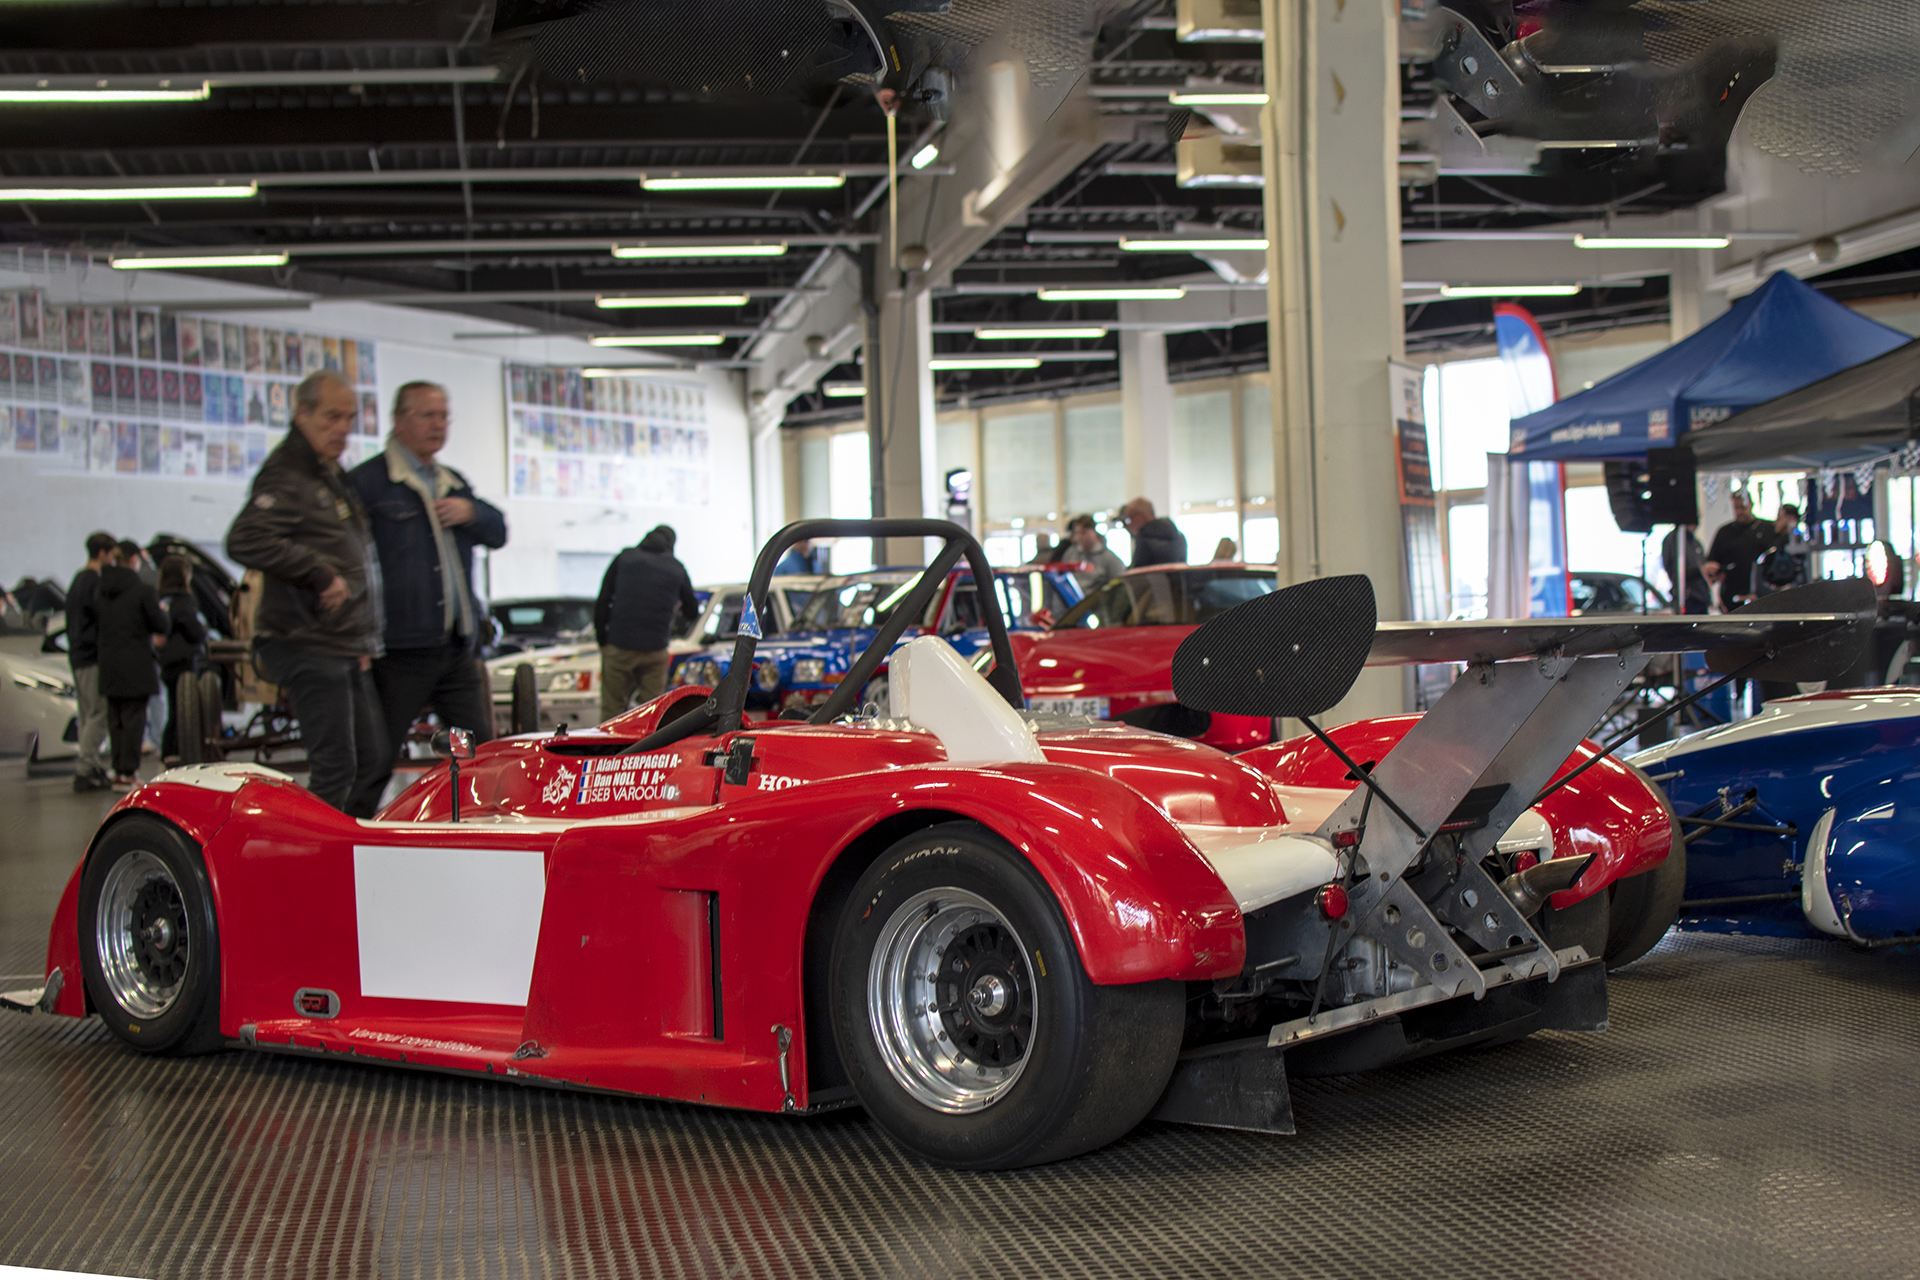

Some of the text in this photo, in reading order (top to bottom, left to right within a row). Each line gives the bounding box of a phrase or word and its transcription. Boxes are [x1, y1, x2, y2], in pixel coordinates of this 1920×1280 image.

[596, 757, 621, 772] Alain
[621, 754, 670, 770] SERPAGGI
[593, 770, 666, 787] Dan NOLL N A+
[591, 787, 611, 802] SEB
